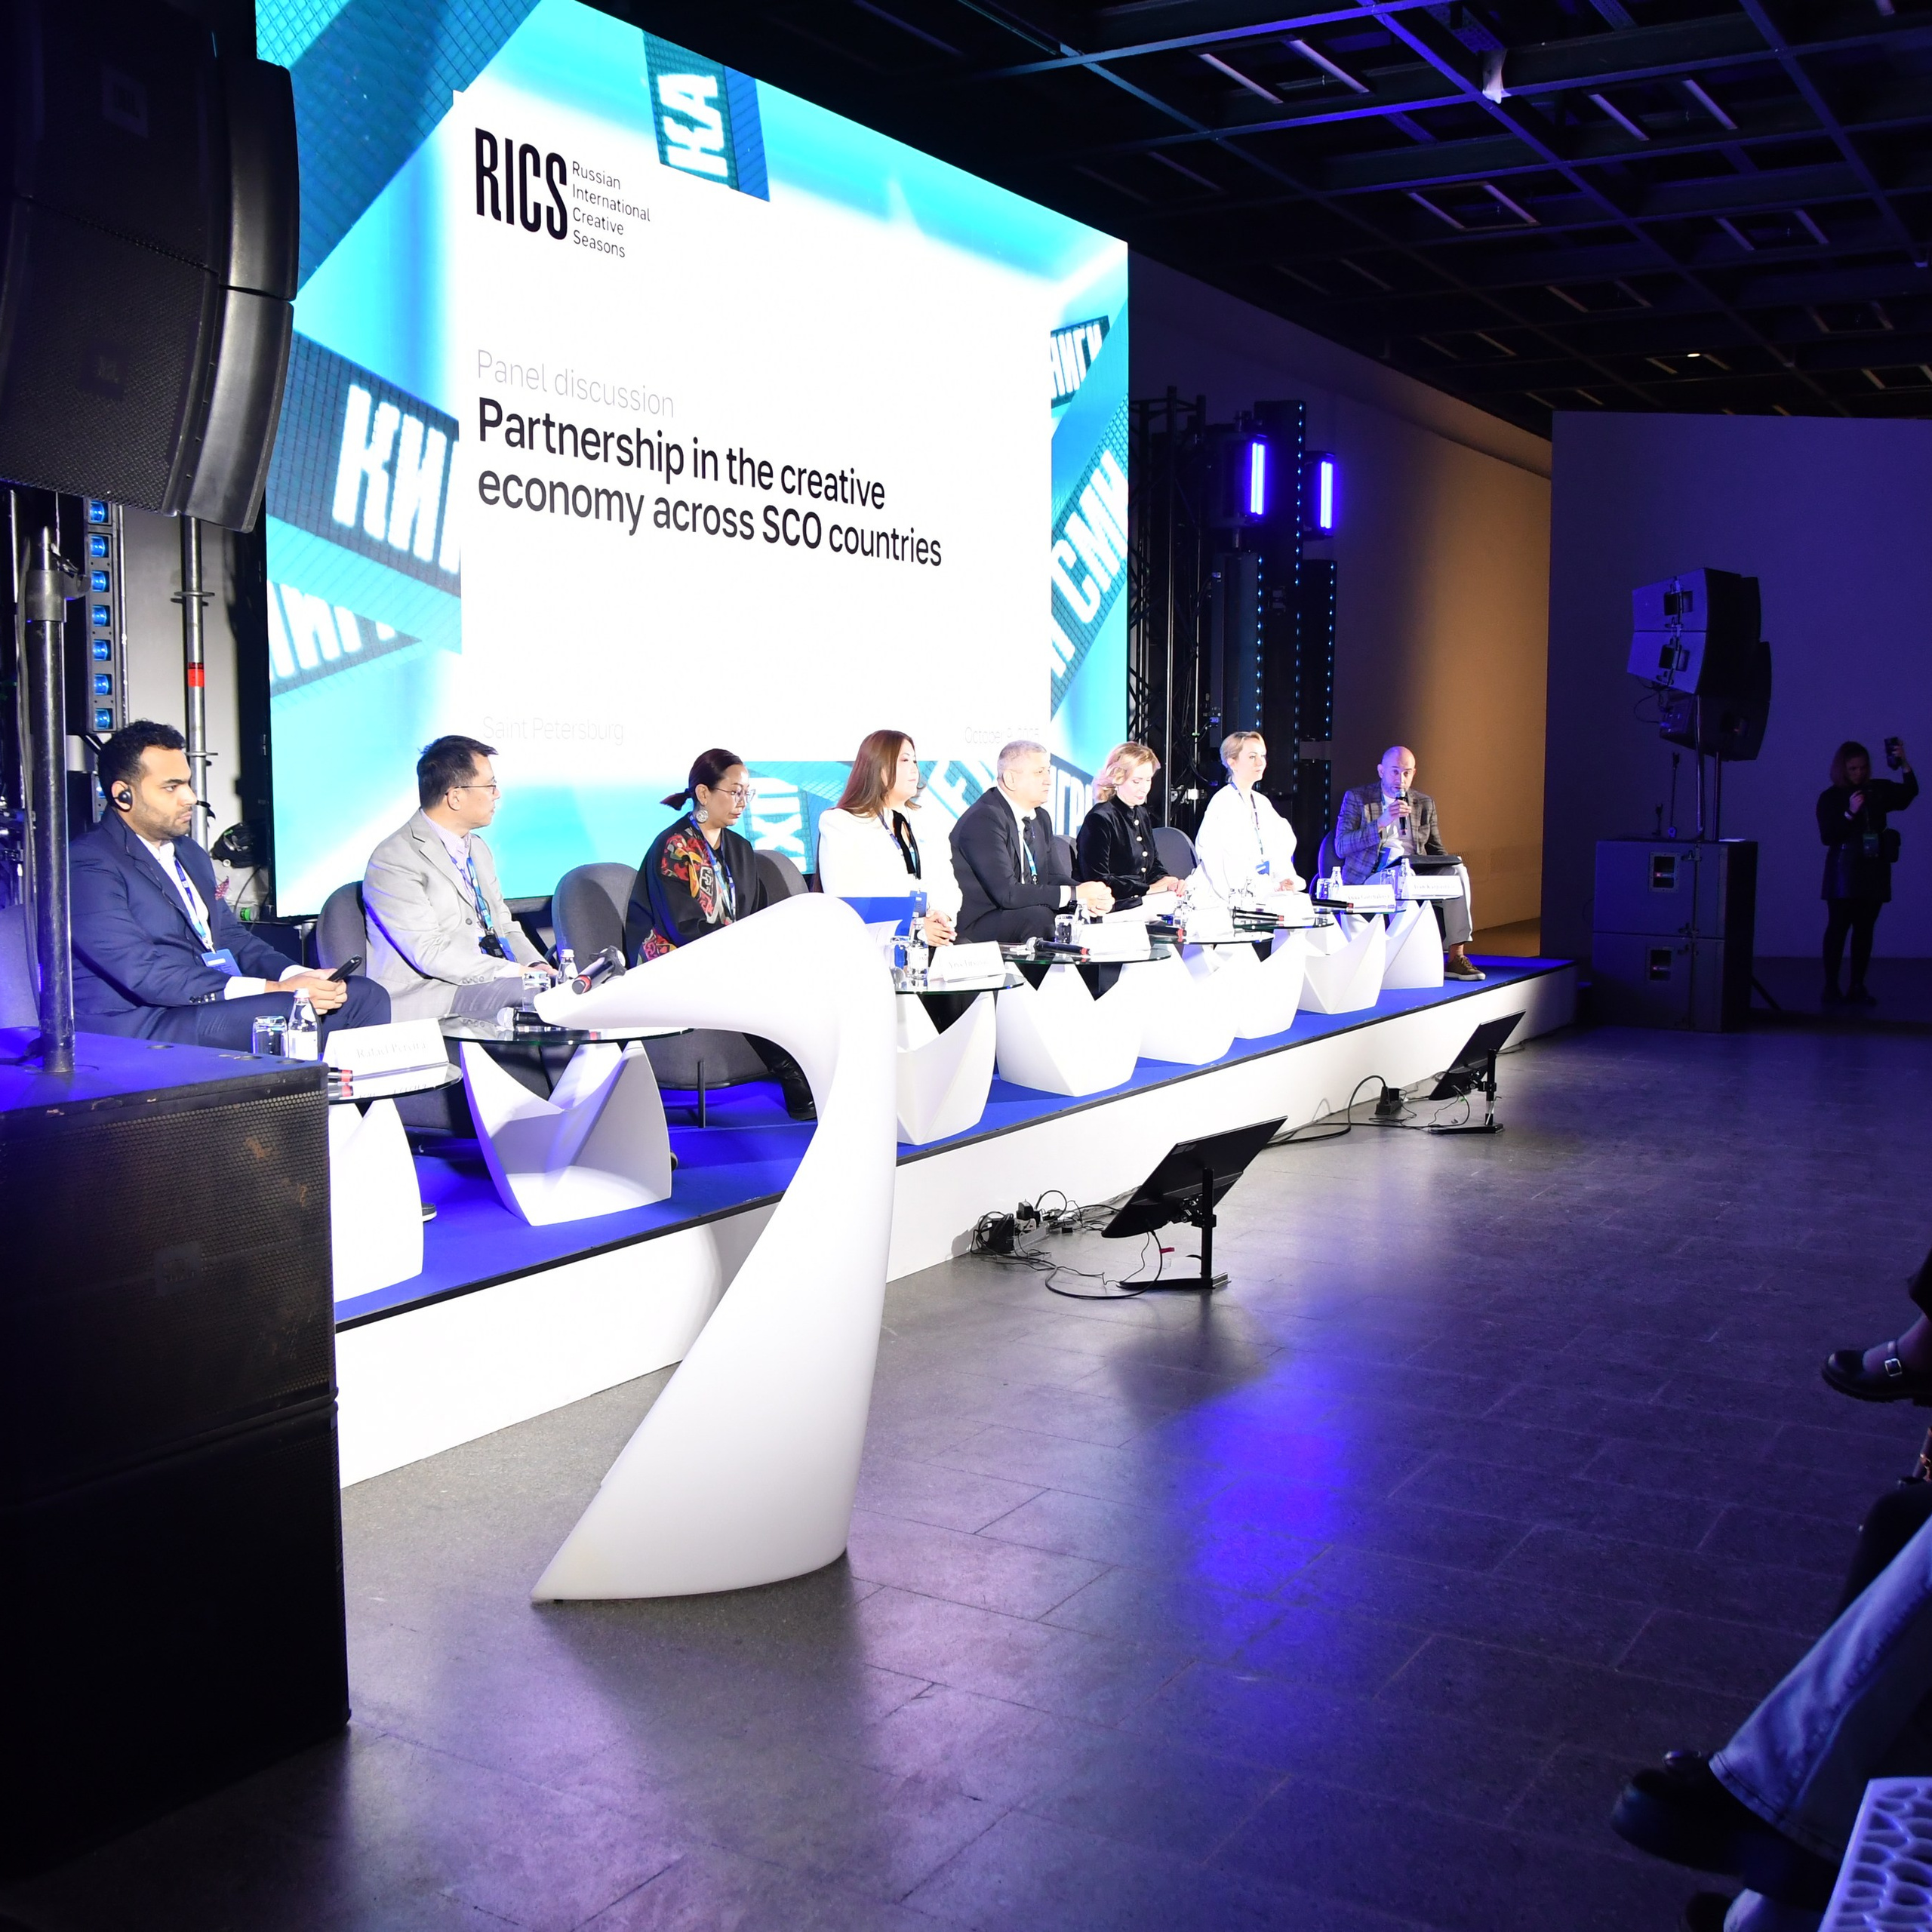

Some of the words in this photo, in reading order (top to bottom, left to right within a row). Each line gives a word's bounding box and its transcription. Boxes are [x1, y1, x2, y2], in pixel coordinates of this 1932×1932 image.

[475, 128, 568, 240] RICS
[573, 161, 620, 189] Russian
[574, 184, 650, 221] International
[574, 208, 623, 235] Creative
[574, 230, 625, 257] Seasons
[478, 349, 547, 392] Panel
[555, 369, 673, 417] discussion
[480, 397, 684, 485] Partnership
[694, 437, 718, 481] in
[727, 448, 773, 490] the
[781, 465, 884, 509] creative
[479, 471, 644, 535] economy
[654, 497, 754, 540] across
[763, 505, 821, 549] SCO
[829, 525, 941, 566] countries
[485, 717, 527, 738] Saint
[534, 718, 623, 745] Petersburg
[965, 726, 1002, 743] October
